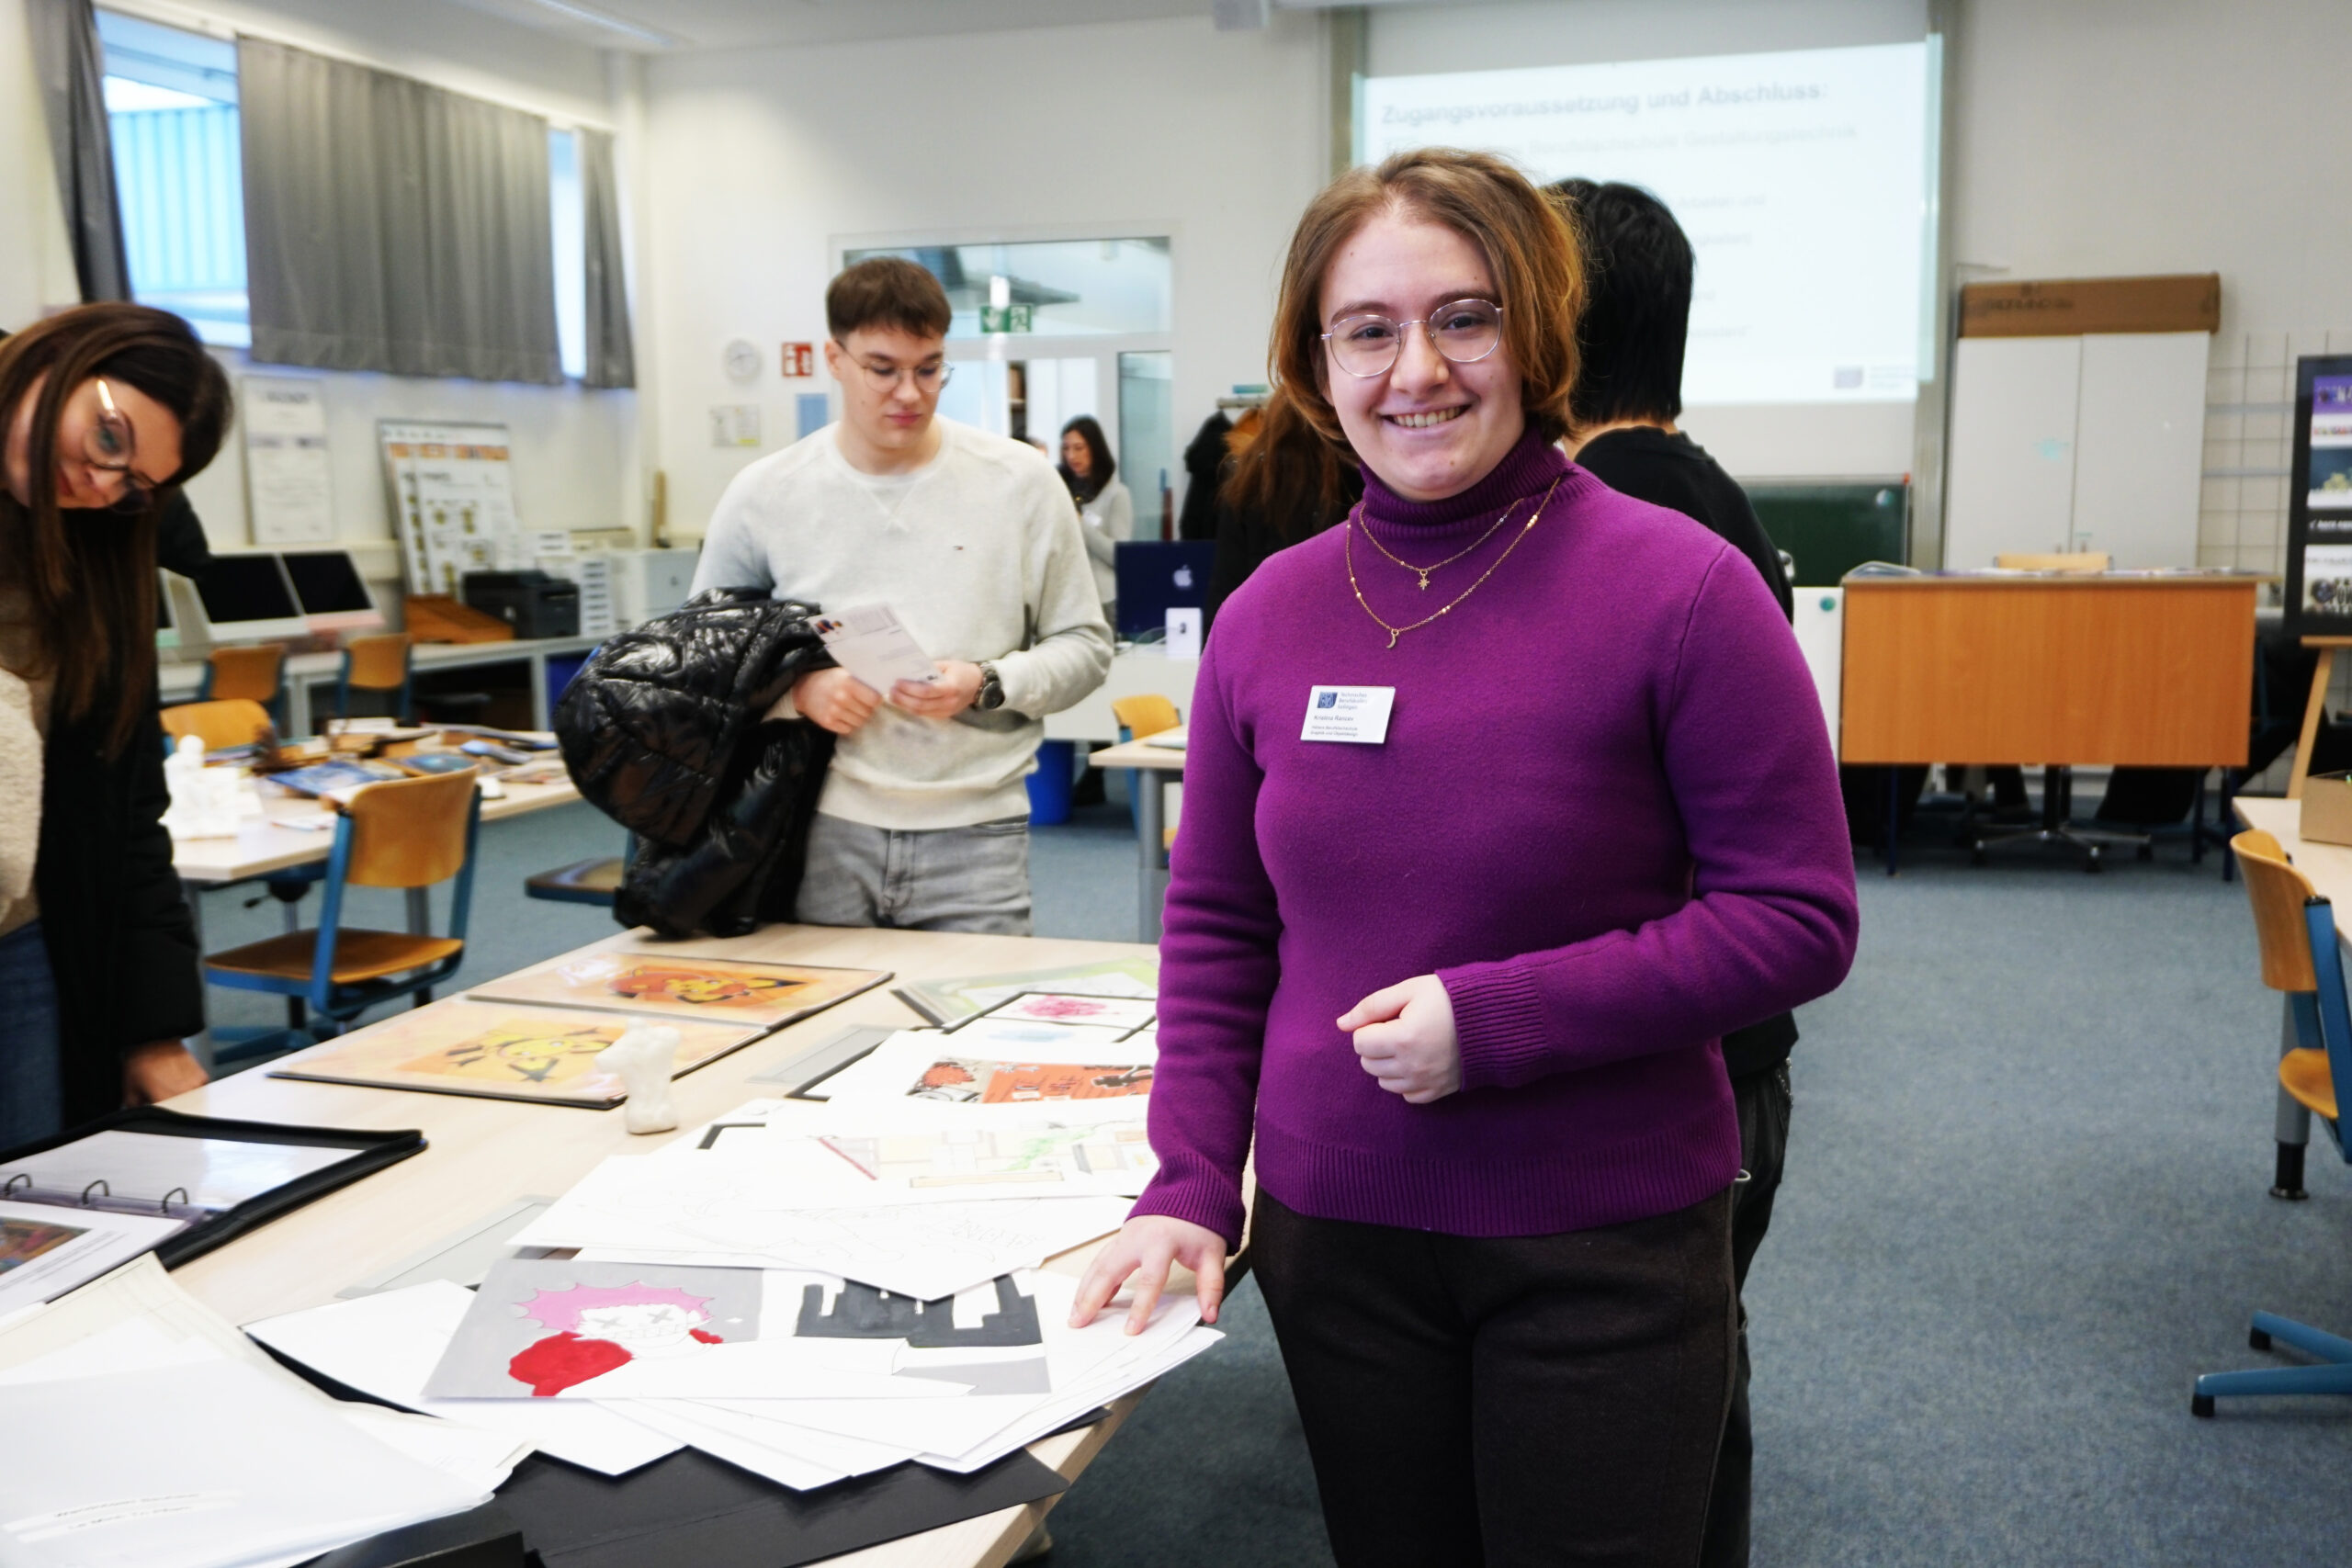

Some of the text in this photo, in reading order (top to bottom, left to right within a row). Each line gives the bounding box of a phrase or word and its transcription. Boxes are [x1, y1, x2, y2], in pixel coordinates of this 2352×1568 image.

[1381, 82, 1828, 127] Zugangsvoraussetzung und Abschluss:
